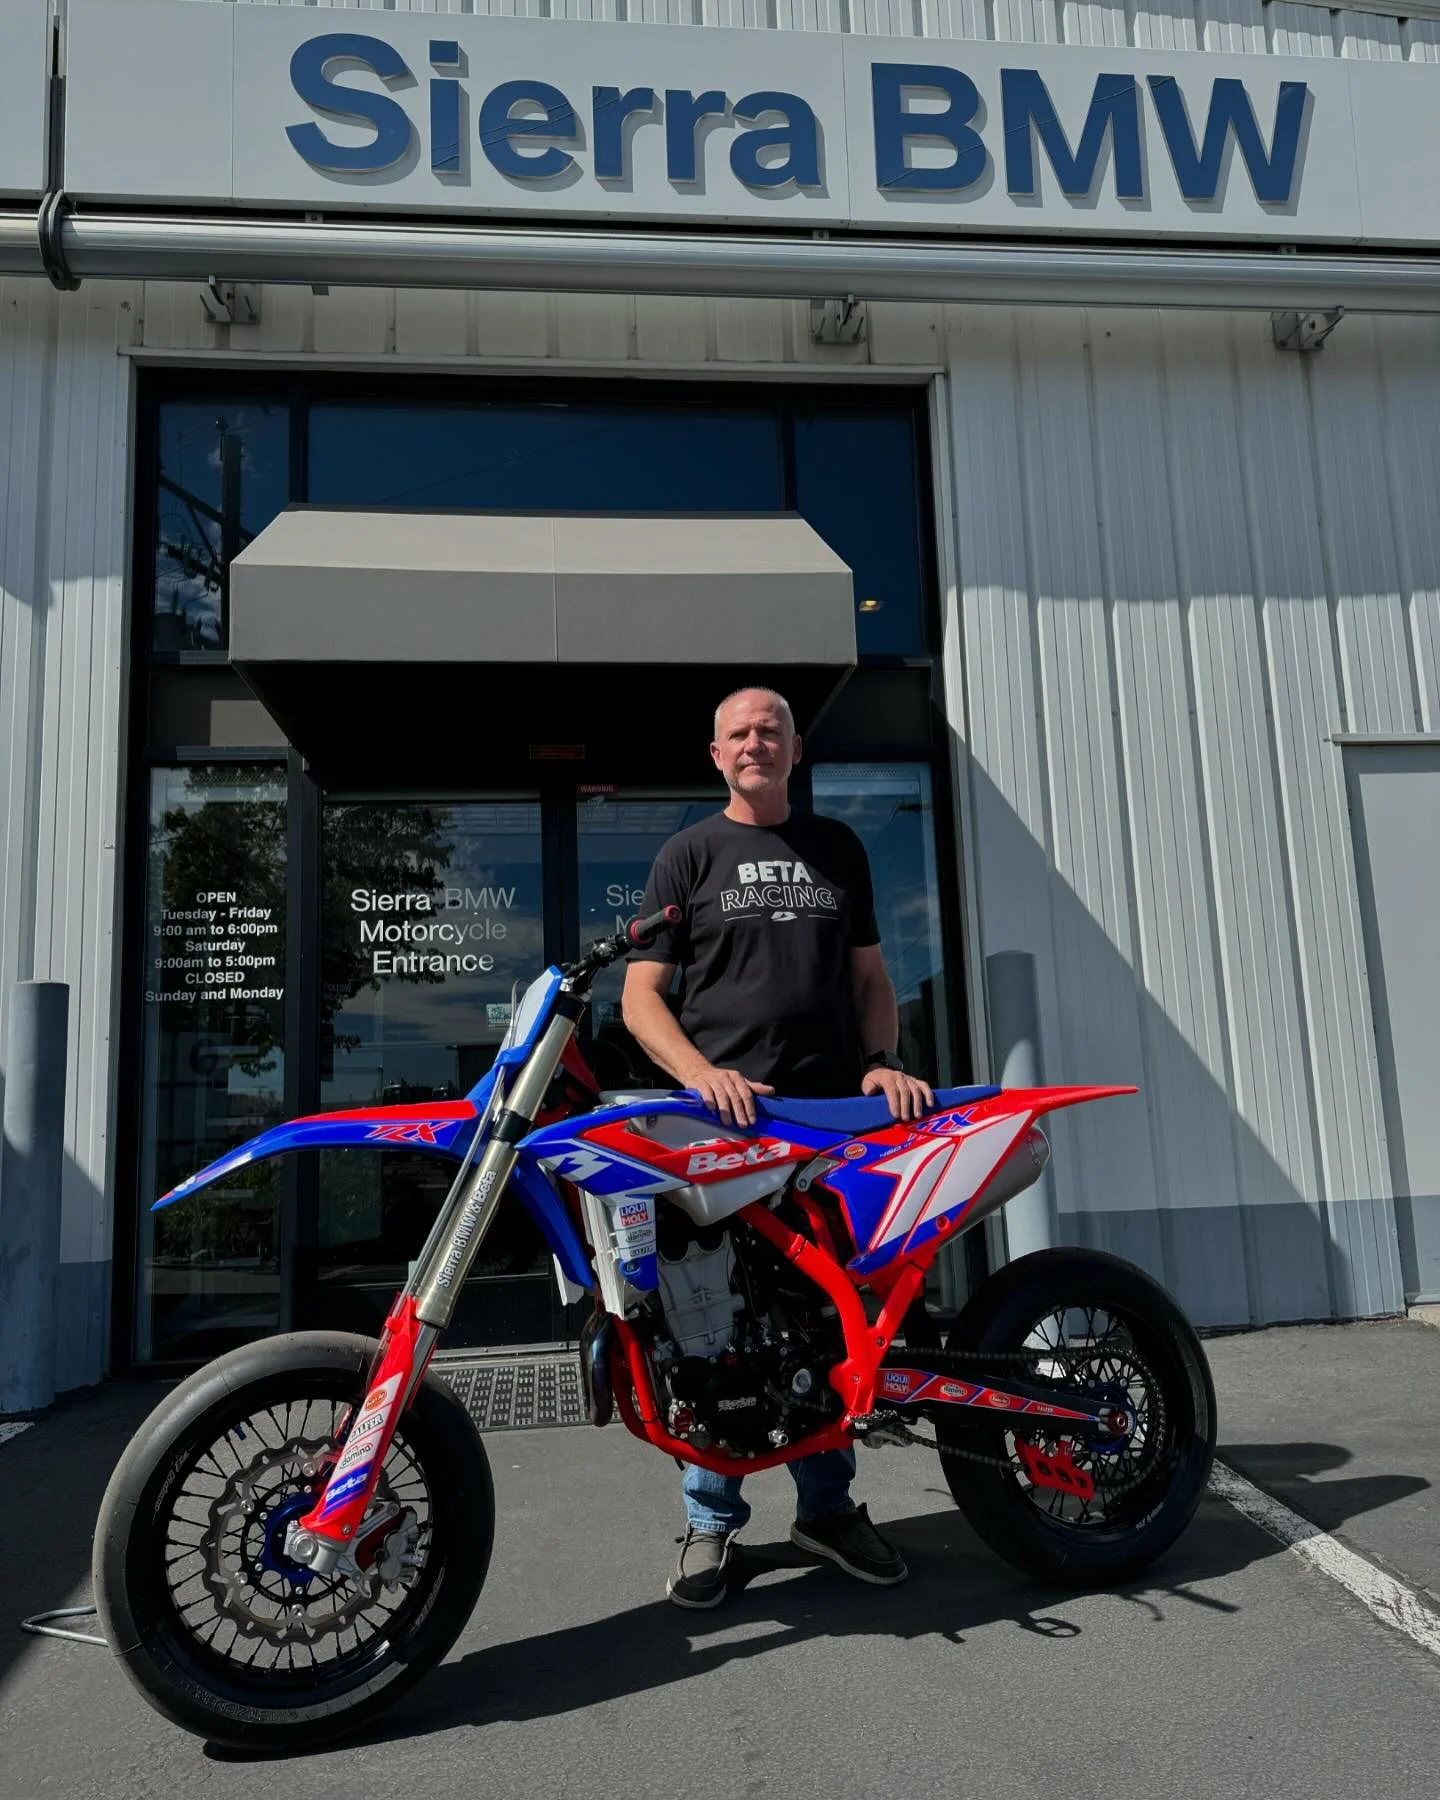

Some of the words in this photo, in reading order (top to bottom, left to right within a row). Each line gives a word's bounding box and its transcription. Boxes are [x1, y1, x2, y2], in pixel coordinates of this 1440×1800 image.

[284, 32, 824, 188] Sierra
[869, 61, 1310, 202] BMW
[738, 861, 813, 884] BETA
[196, 892, 236, 903] OPEN
[351, 889, 431, 912] Sierra
[444, 888, 516, 909] BMW
[606, 884, 645, 906] Sie
[720, 885, 838, 912] RACING
[160, 909, 216, 921] Tuesday
[229, 907, 271, 920] Friday
[153, 925, 182, 936] 9:00
[186, 927, 206, 935] am
[210, 925, 224, 935] to
[228, 923, 278, 936] 6:00pm
[360, 918, 507, 945] Motorcycle
[185, 940, 245, 952] Saturday
[155, 958, 203, 968] 9:00am
[208, 957, 221, 967] to
[226, 956, 275, 968] 5:00pm
[372, 951, 494, 974] Entrance
[185, 972, 245, 984] CLOSED
[145, 990, 196, 1003] Sunday
[201, 988, 226, 999] and
[230, 987, 283, 1000] Monday
[686, 1141, 791, 1175] Beta
[473, 1170, 497, 1203] Beta
[470, 1203, 482, 1214] &
[621, 1203, 645, 1216] LIQUI
[622, 1212, 647, 1225] MOLY
[452, 1212, 477, 1248] BMW
[437, 1249, 461, 1288] Sierra
[885, 1382, 909, 1393] MOLY
[886, 1374, 908, 1383] LIQUI
[326, 1472, 367, 1500] Beta
